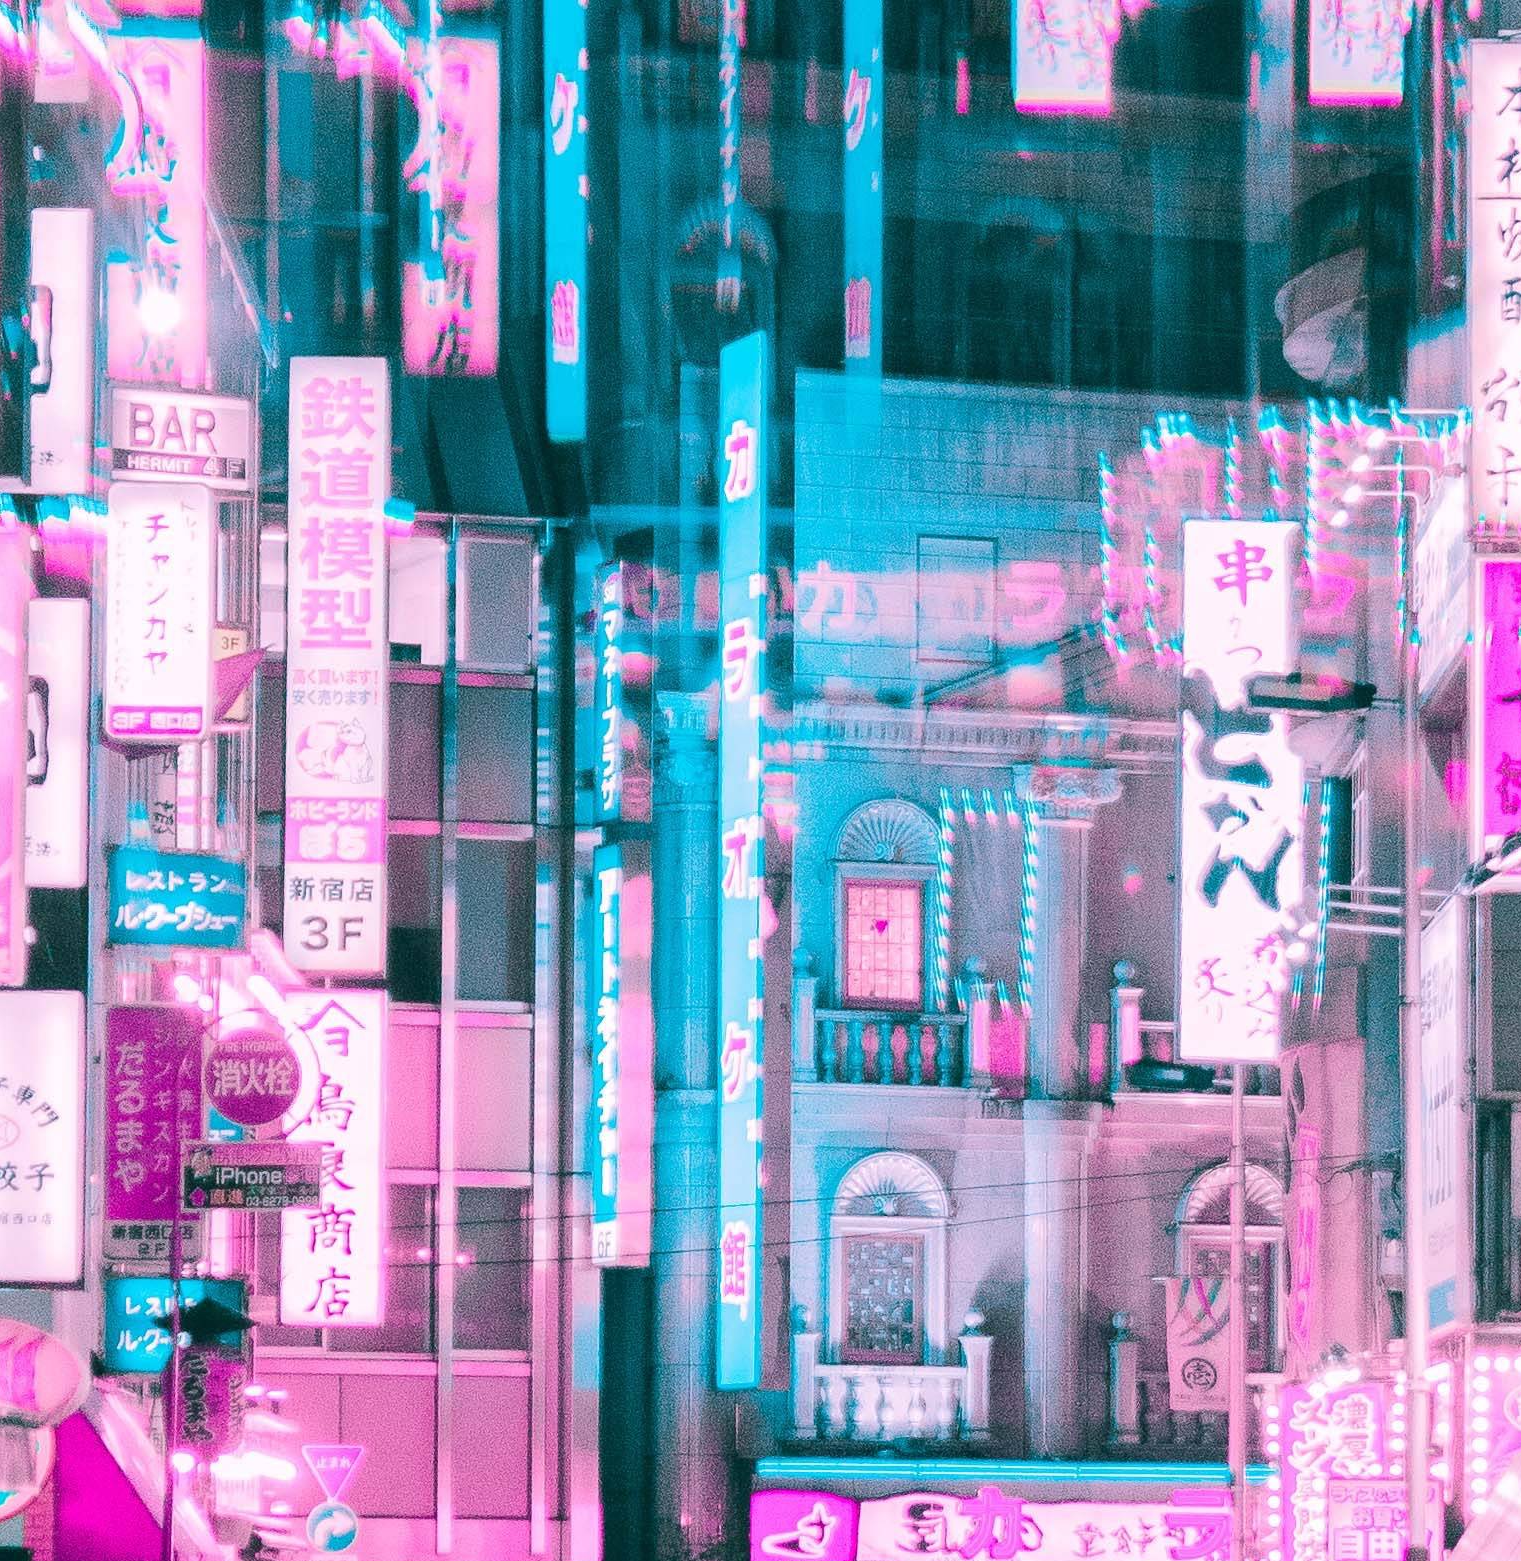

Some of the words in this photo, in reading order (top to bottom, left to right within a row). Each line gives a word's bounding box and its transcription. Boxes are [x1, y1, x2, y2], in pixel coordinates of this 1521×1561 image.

[130, 402, 218, 455] BAR
[128, 453, 191, 473] HERMIT
[299, 375, 377, 649] 鉄道模型
[221, 636, 239, 651] 3F
[292, 669, 379, 685] 高く買います!
[292, 688, 379, 705] 安く売ります!
[125, 870, 227, 894] レストラン
[289, 877, 374, 901] 新宿店
[300, 915, 364, 951] 3F
[597, 868, 620, 1198] アートネイチャー
[214, 1058, 294, 1097] 消火栓
[114, 1039, 148, 1193] だるまや
[216, 1167, 282, 1185] iPhone
[596, 1230, 613, 1259] 6F
[316, 1455, 352, 1469] 止まれ
